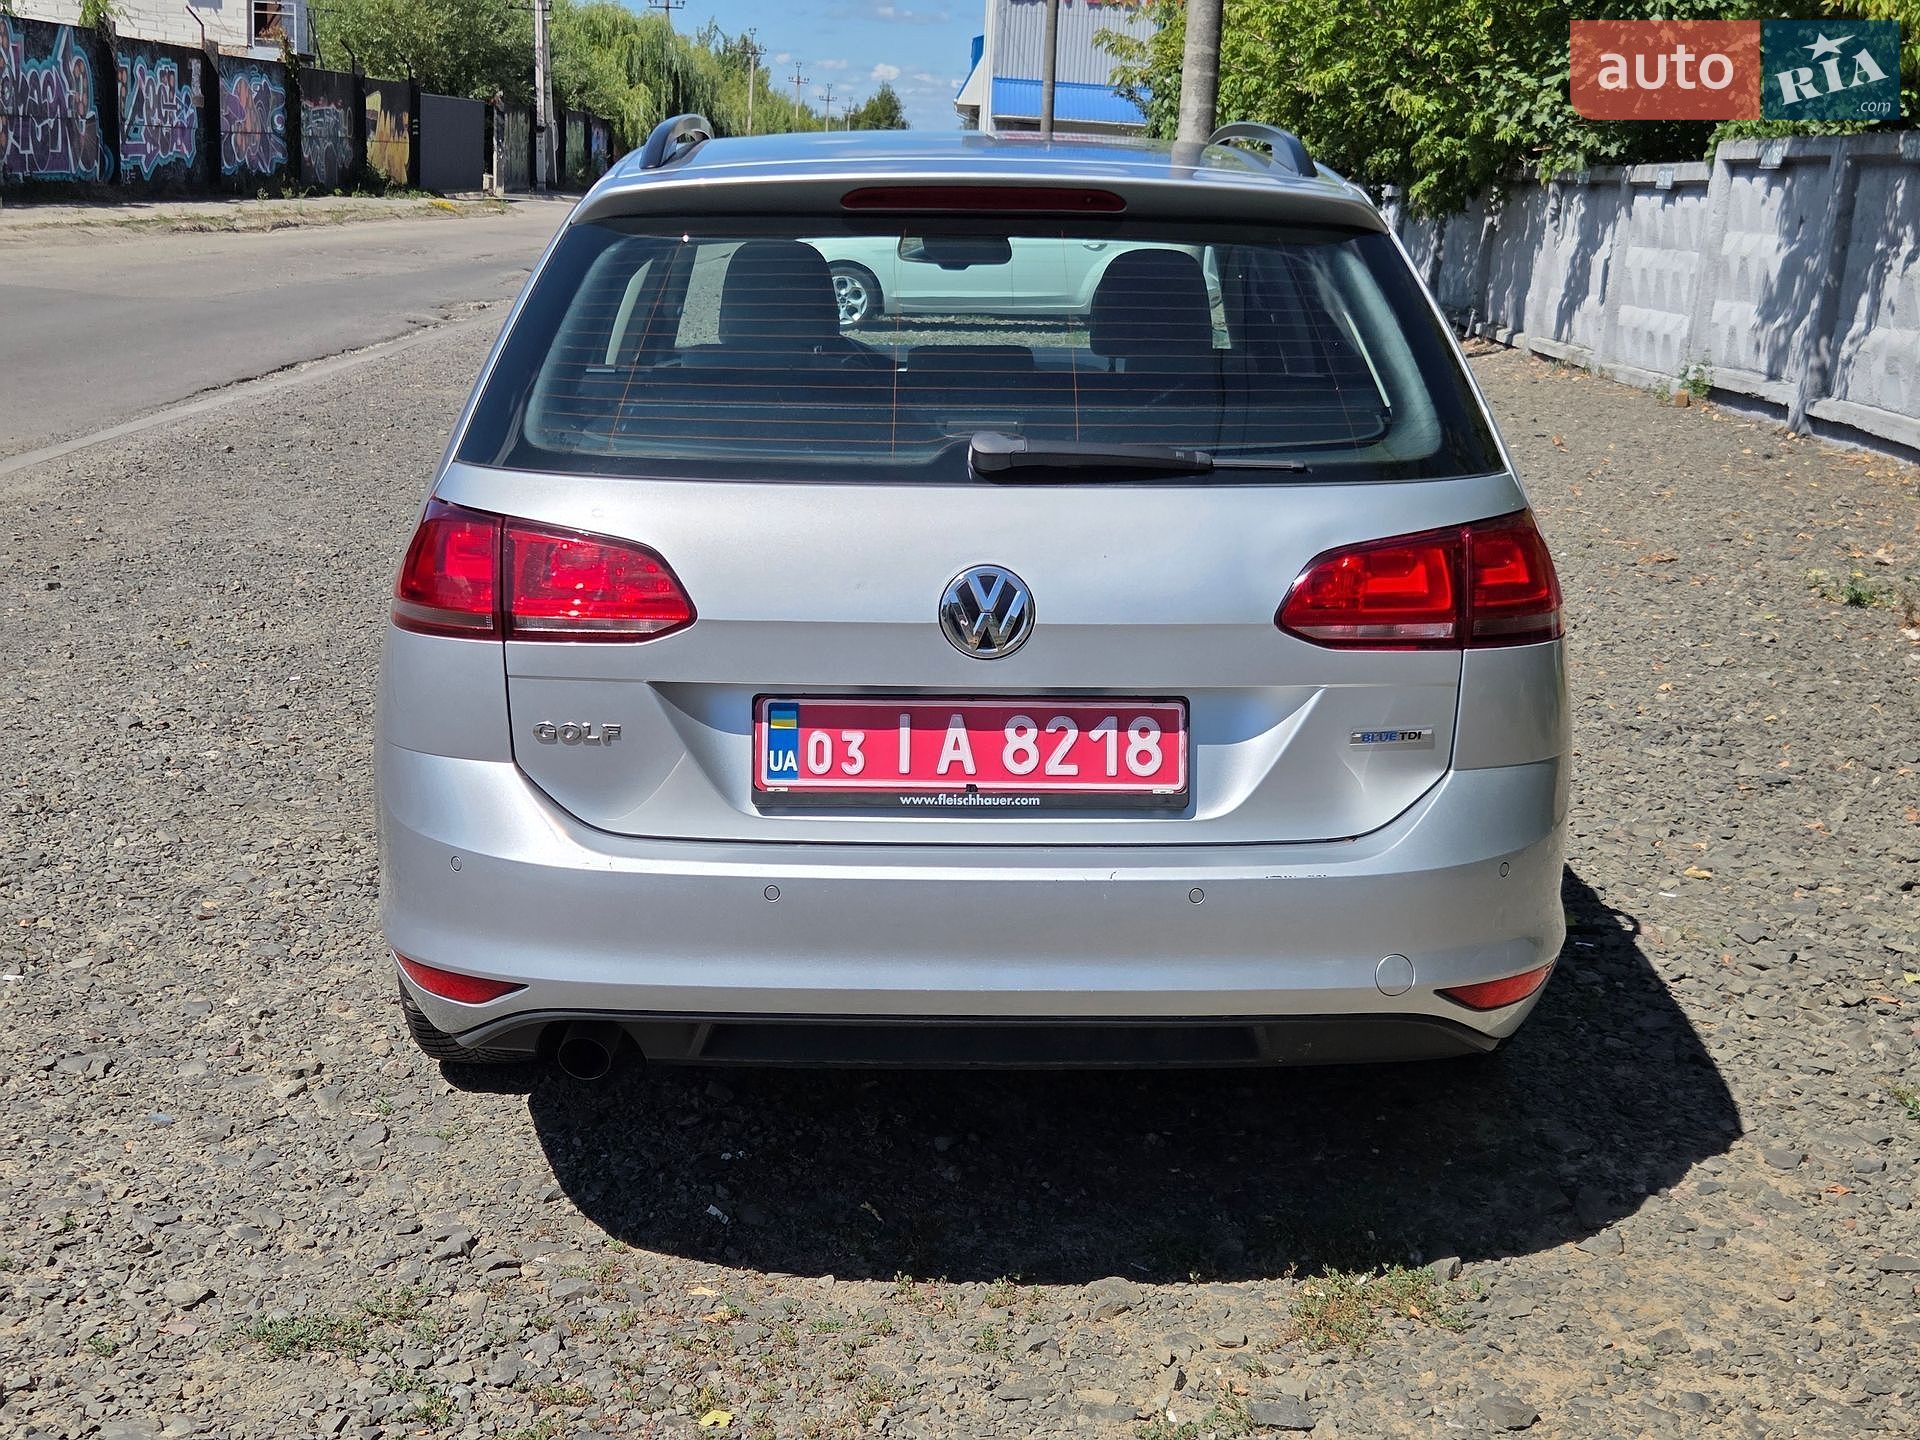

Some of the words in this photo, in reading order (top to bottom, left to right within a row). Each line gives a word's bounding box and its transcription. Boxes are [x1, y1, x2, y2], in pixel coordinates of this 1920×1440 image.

[533, 721, 622, 746] GOLF
[807, 730, 865, 775] 03
[1002, 714, 1163, 776] 8218
[769, 750, 798, 771] UA
[900, 794, 1040, 807] www.fleischhauer.com
